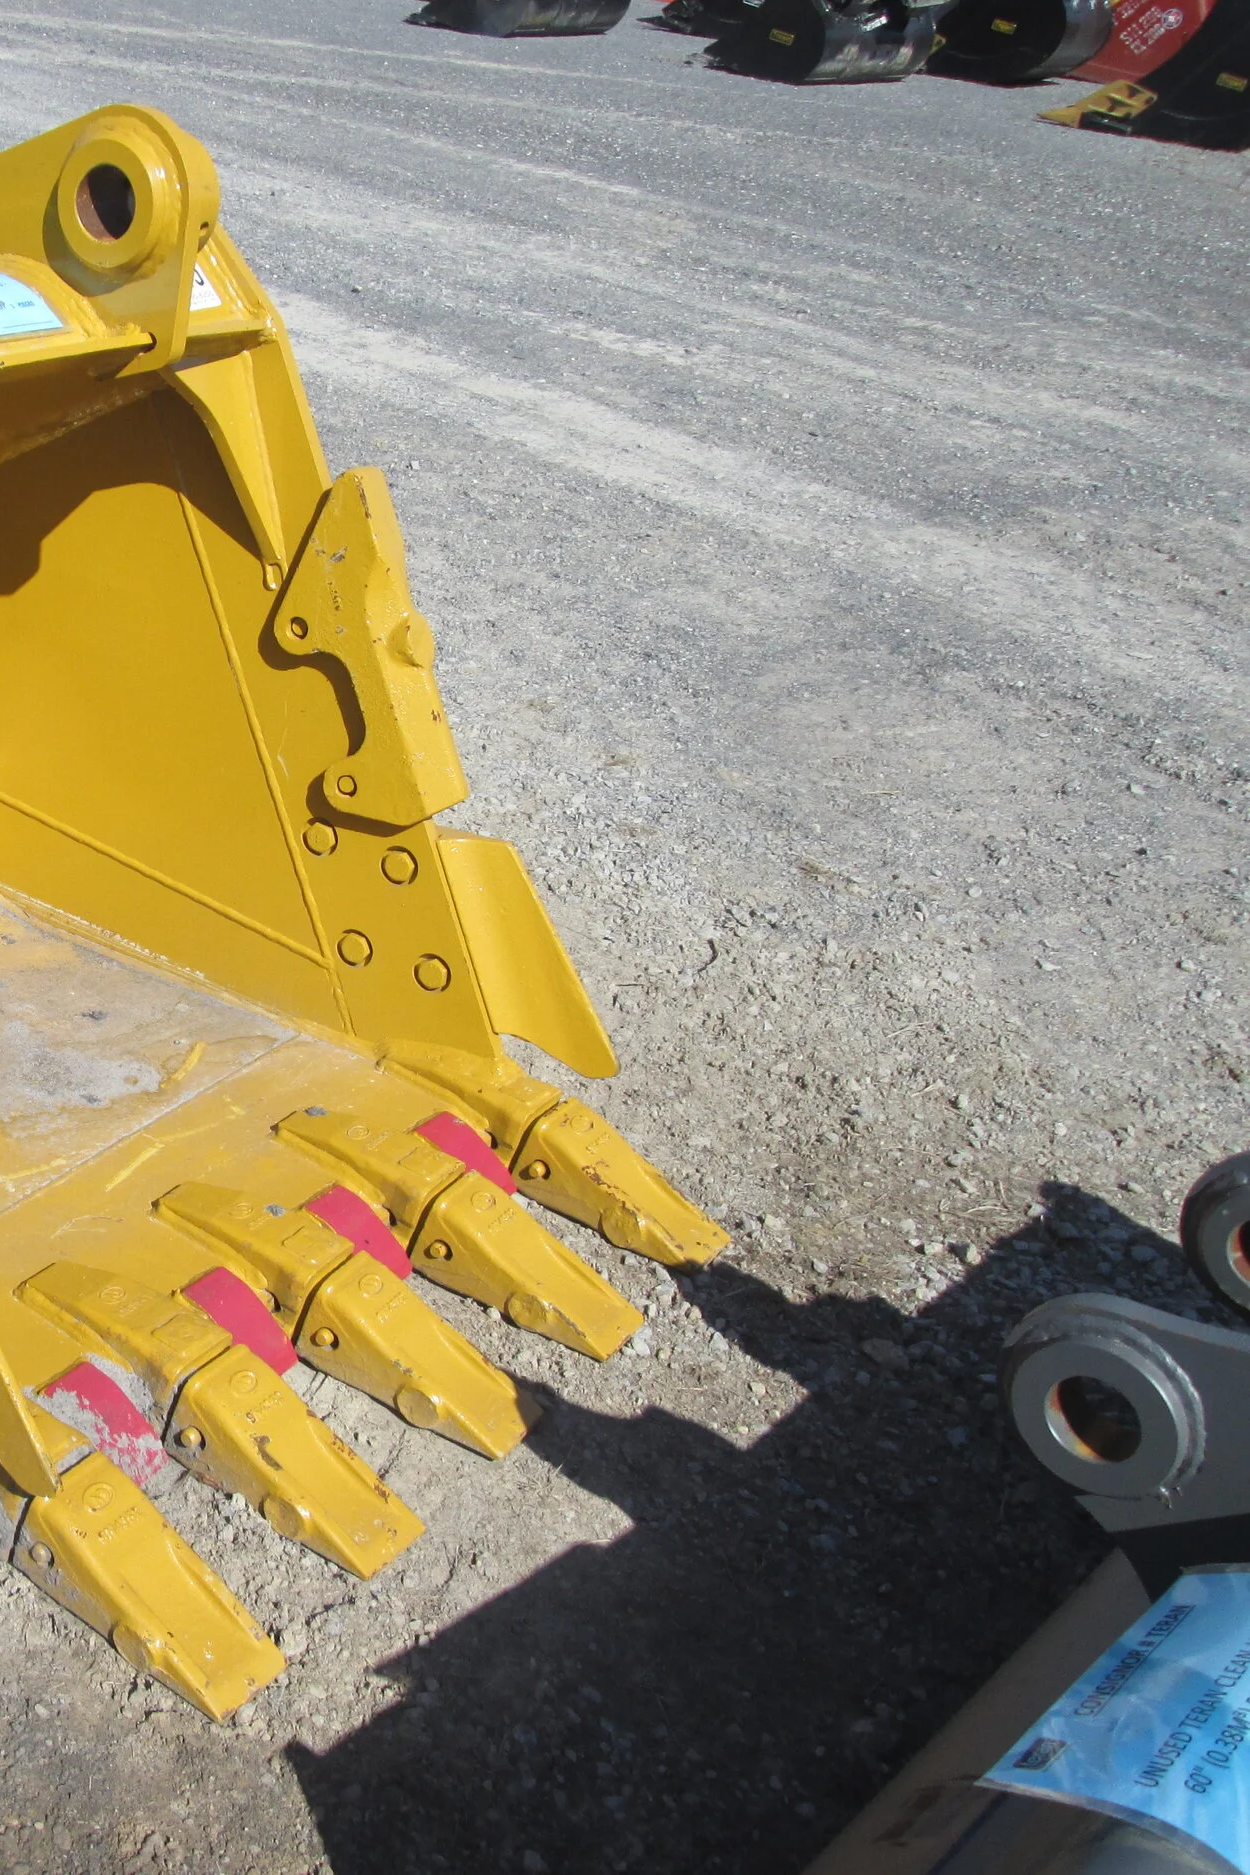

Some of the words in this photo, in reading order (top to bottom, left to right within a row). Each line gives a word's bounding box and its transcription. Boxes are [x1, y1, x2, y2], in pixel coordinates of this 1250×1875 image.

[1074, 1648, 1149, 1717] CONSIGNOR
[1144, 1604, 1192, 1640] TERAN
[1134, 1731, 1193, 1788] UNUSED
[1179, 1688, 1228, 1729] TERAN
[1184, 1765, 1213, 1794] 60"
